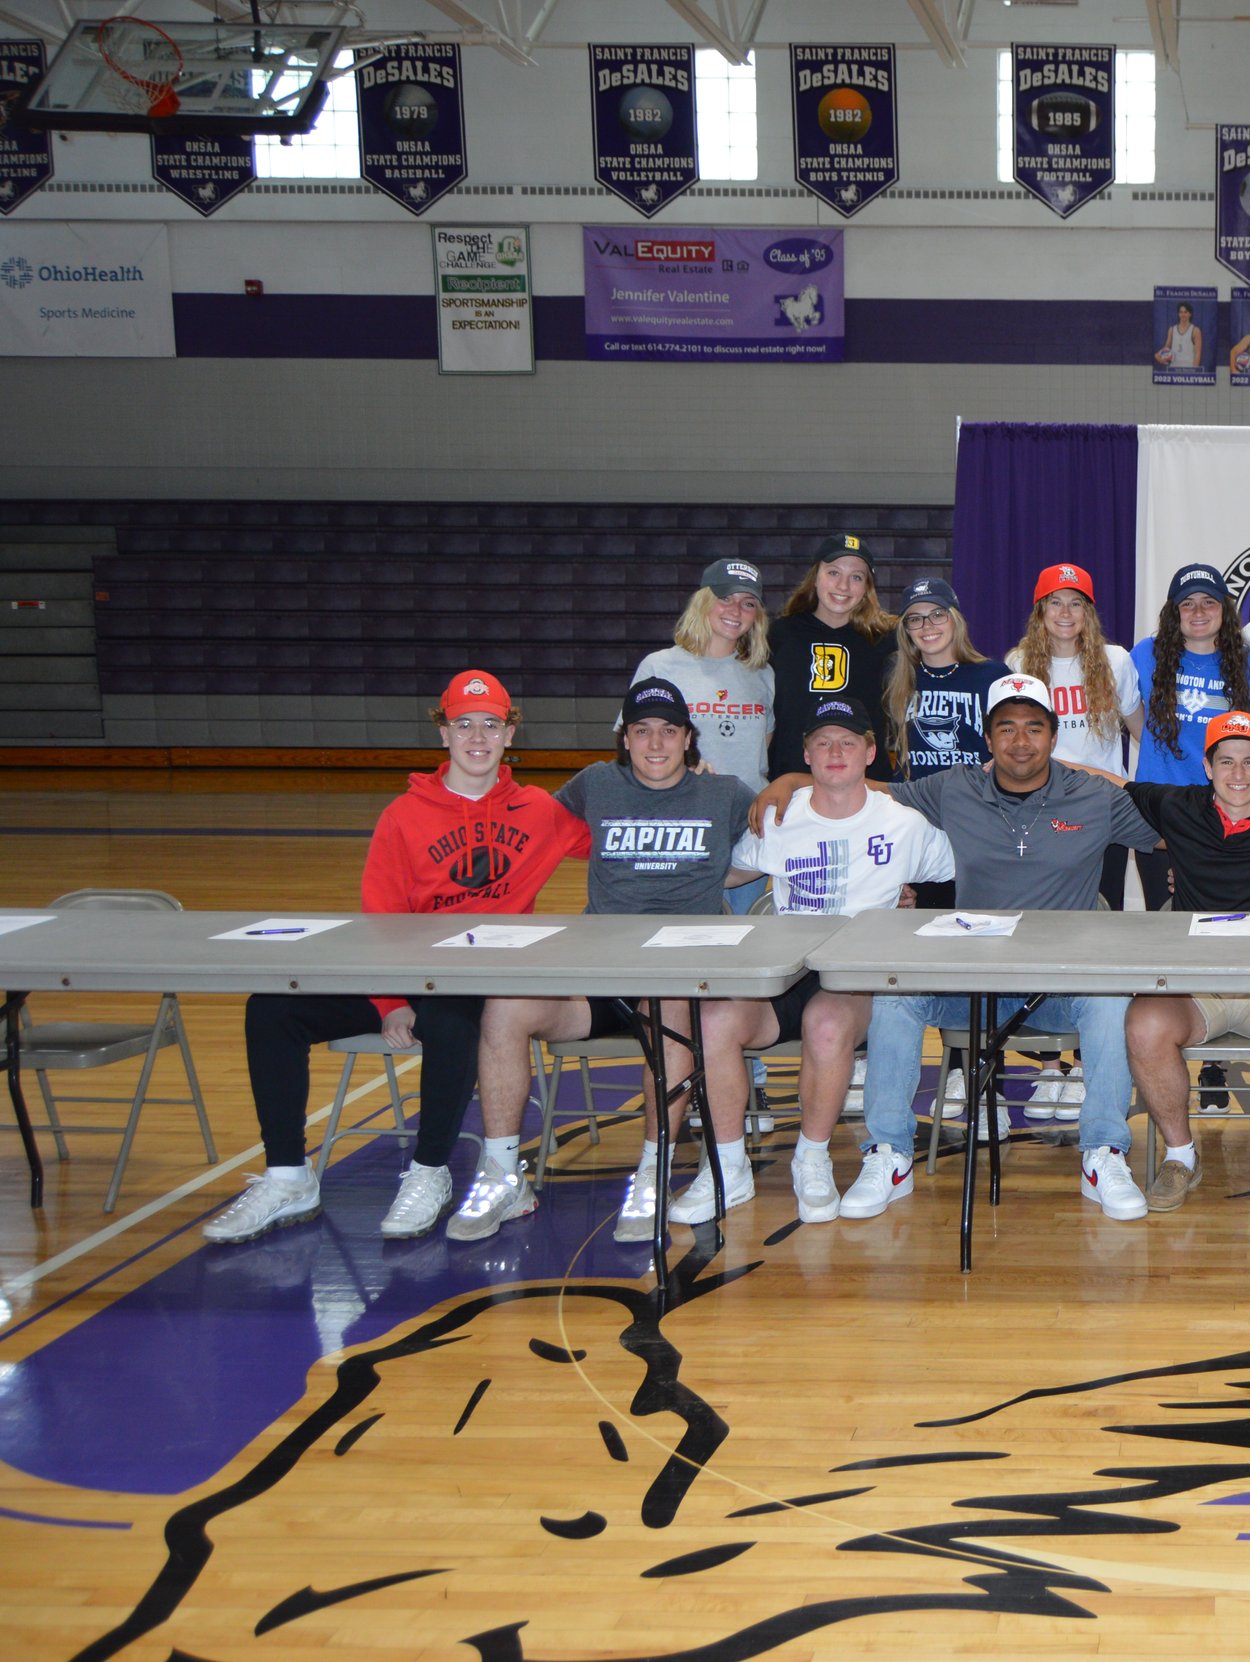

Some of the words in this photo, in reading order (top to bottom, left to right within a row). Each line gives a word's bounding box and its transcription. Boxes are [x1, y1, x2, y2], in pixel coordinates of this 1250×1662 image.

[401, 45, 453, 56] FRANCIS
[363, 60, 454, 89] DeSALES
[598, 64, 688, 92] DeSALES
[799, 64, 888, 92] DeSALES
[1019, 64, 1108, 92] DeSALES
[395, 106, 428, 118] 1979
[629, 109, 661, 122] 1982
[829, 109, 862, 122] 1982
[1049, 112, 1081, 125] 1985
[186, 141, 220, 152] OHSAA
[397, 141, 431, 152] OHSAA
[157, 156, 187, 166] STATE
[190, 156, 251, 166] CHAMPIONS
[367, 155, 398, 165] STATE
[402, 155, 461, 166] CHAMPIONS
[170, 170, 239, 179] WRESTLING
[385, 169, 445, 178] BASEBALL
[612, 172, 683, 181] VOLLEYBALL
[810, 172, 838, 181] BOYS
[841, 172, 884, 181] TENNIS
[1037, 172, 1092, 182] FOOTBALL
[438, 232, 493, 245] Respect
[1221, 237, 1250, 248] STATE
[447, 251, 486, 262] GAME
[769, 249, 797, 262] Class
[799, 255, 810, 267] of
[39, 266, 144, 282] OhioHealth
[659, 264, 680, 273] Real
[684, 265, 713, 273] Estate
[447, 277, 520, 290] Recipient
[611, 288, 665, 302] Jennifer
[668, 290, 729, 303] Valentine
[442, 299, 527, 308] SPORTSMANSHIP
[39, 307, 78, 320] Sports
[81, 307, 135, 319] Medicine
[452, 320, 520, 330] EXPECTATION!
[611, 315, 733, 326] www.valequityrealestate.com
[704, 345, 712, 353] to
[714, 345, 742, 353] discuss
[744, 345, 758, 353] real
[761, 345, 784, 353] estate
[786, 344, 805, 354] right
[806, 345, 826, 353] now!
[905, 690, 983, 737] ARIETTA
[428, 825, 467, 864] OHIO
[475, 821, 529, 853] STATE
[606, 827, 707, 851] CAPITAL
[634, 862, 676, 871] UNIVERSITY
